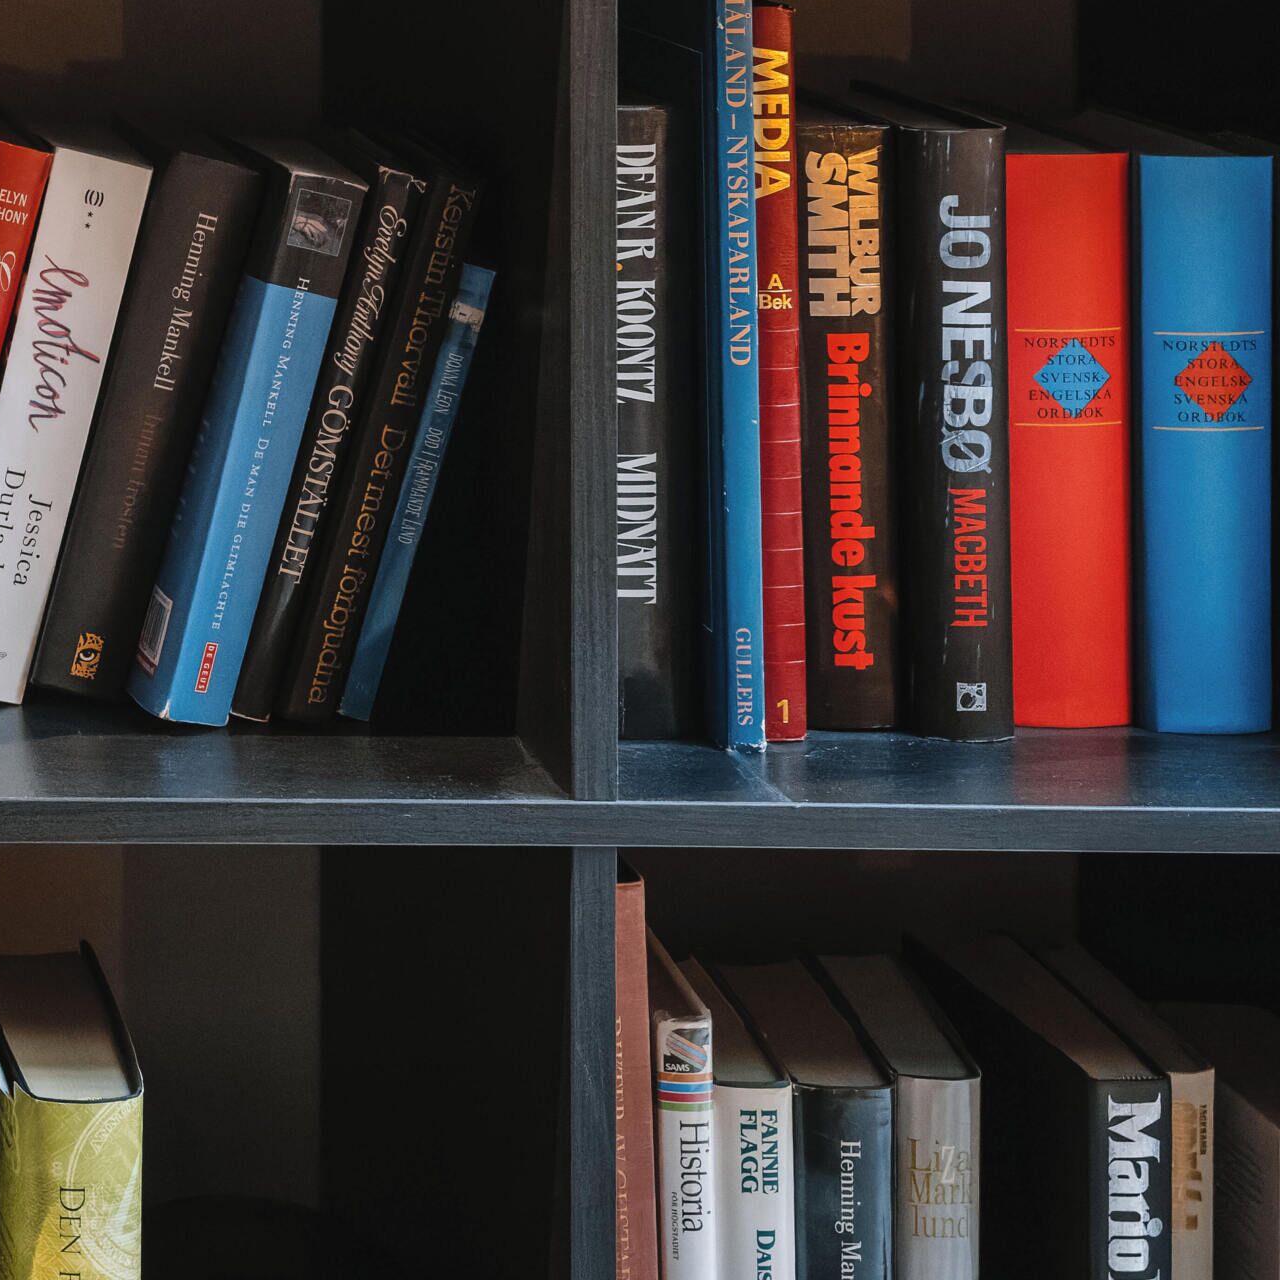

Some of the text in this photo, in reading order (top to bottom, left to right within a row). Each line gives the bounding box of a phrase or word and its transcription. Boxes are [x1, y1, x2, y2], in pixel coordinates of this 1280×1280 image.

[752, 46, 791, 198] MEDIA
[152, 212, 218, 391] Henning Mankell
[727, 135, 753, 367] NYSKAPARLAND
[939, 195, 994, 627] JO NESBØ MACBETH
[12, 494, 53, 586] Jessica
[825, 333, 877, 670] Brinnande kust
[733, 627, 754, 727] GULLERS
[679, 1120, 711, 1233] Historia
[740, 1109, 758, 1194] FLAGG
[761, 1109, 778, 1194] FANNIE
[835, 1140, 861, 1234] Henning
[1106, 1092, 1163, 1273] Mario
